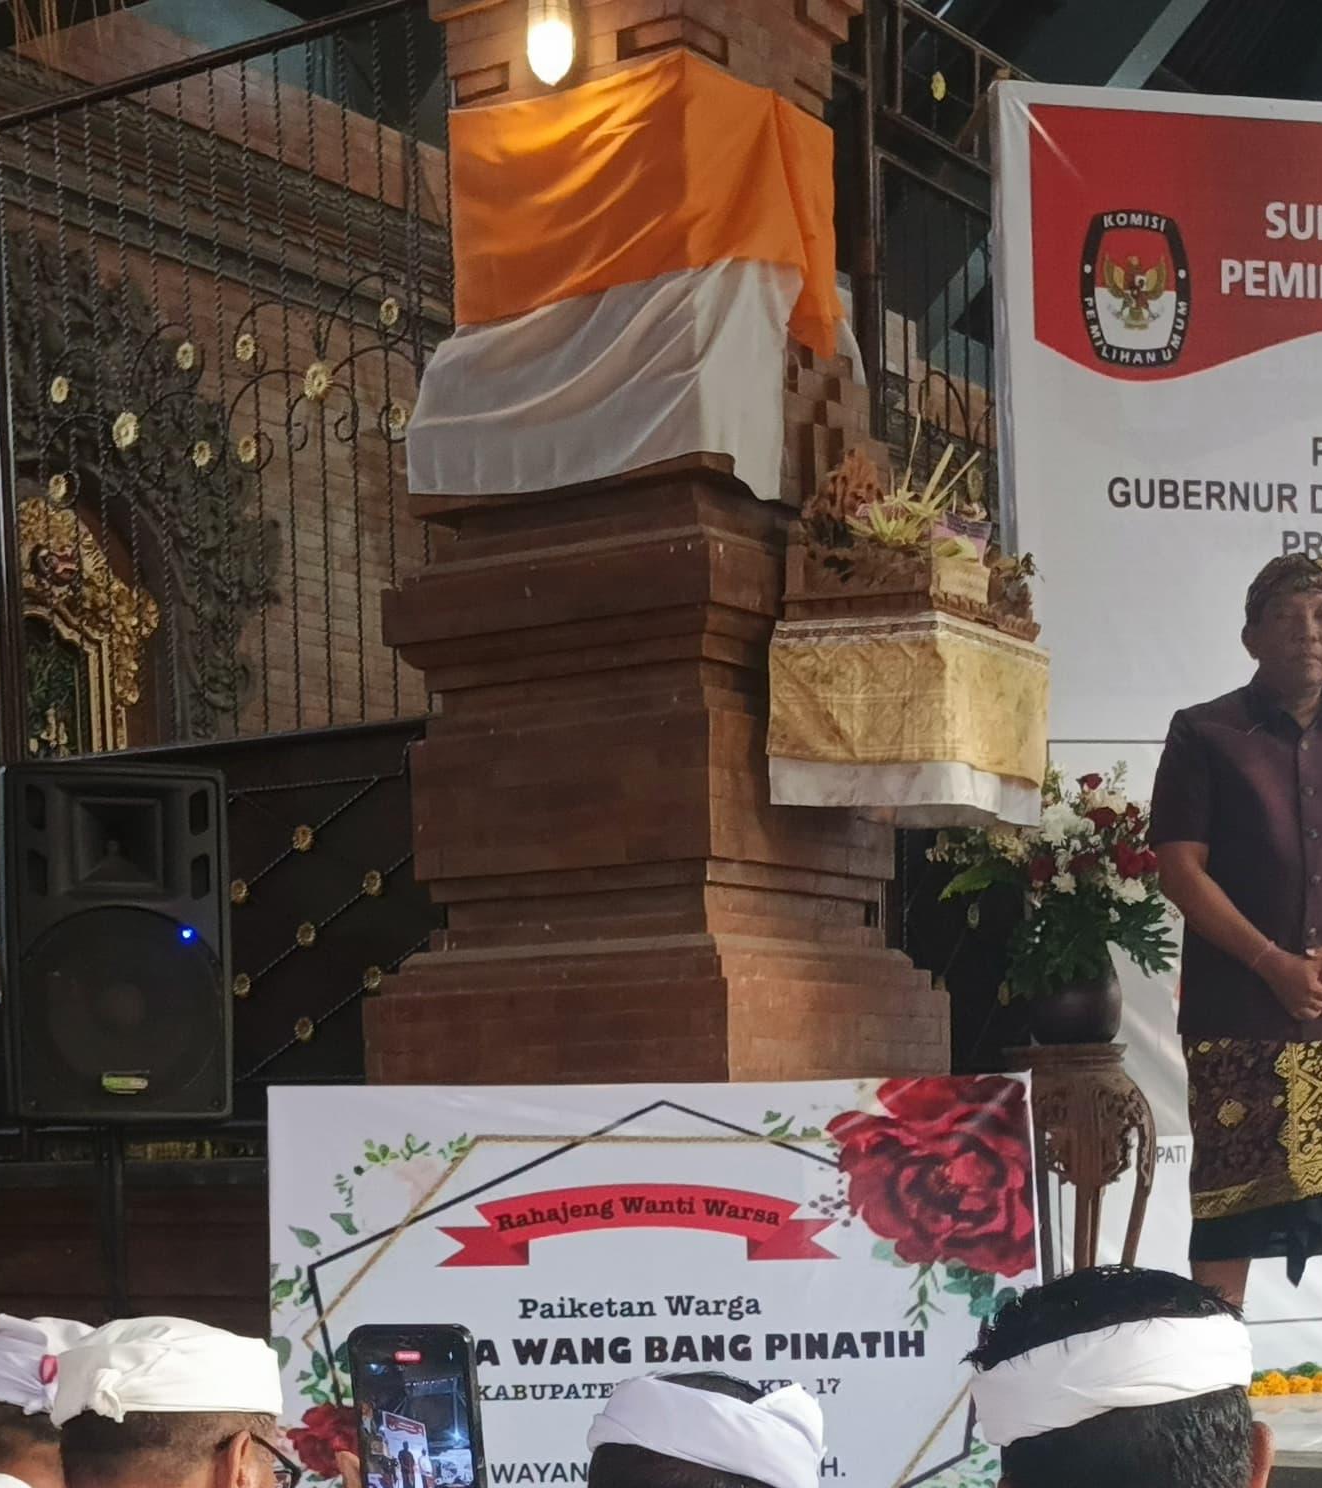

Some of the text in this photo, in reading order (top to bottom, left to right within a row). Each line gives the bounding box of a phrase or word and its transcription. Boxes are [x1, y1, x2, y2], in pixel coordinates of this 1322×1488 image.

[1103, 203, 1166, 232] KOMISI
[1084, 297, 1188, 364] PEMILIHAN UMUM
[1107, 475, 1298, 515] GUBERNUR
[495, 1196, 781, 1233] Rahajeng Wanti Warsa
[518, 1296, 762, 1321] Paiketan Warga
[512, 1337, 632, 1366] WANG
[644, 1334, 753, 1364] BANG
[765, 1331, 927, 1362] PINATIH
[476, 1383, 619, 1401] KABUPATE
[815, 1378, 841, 1395] 17
[491, 1461, 589, 1485] WAYAN
